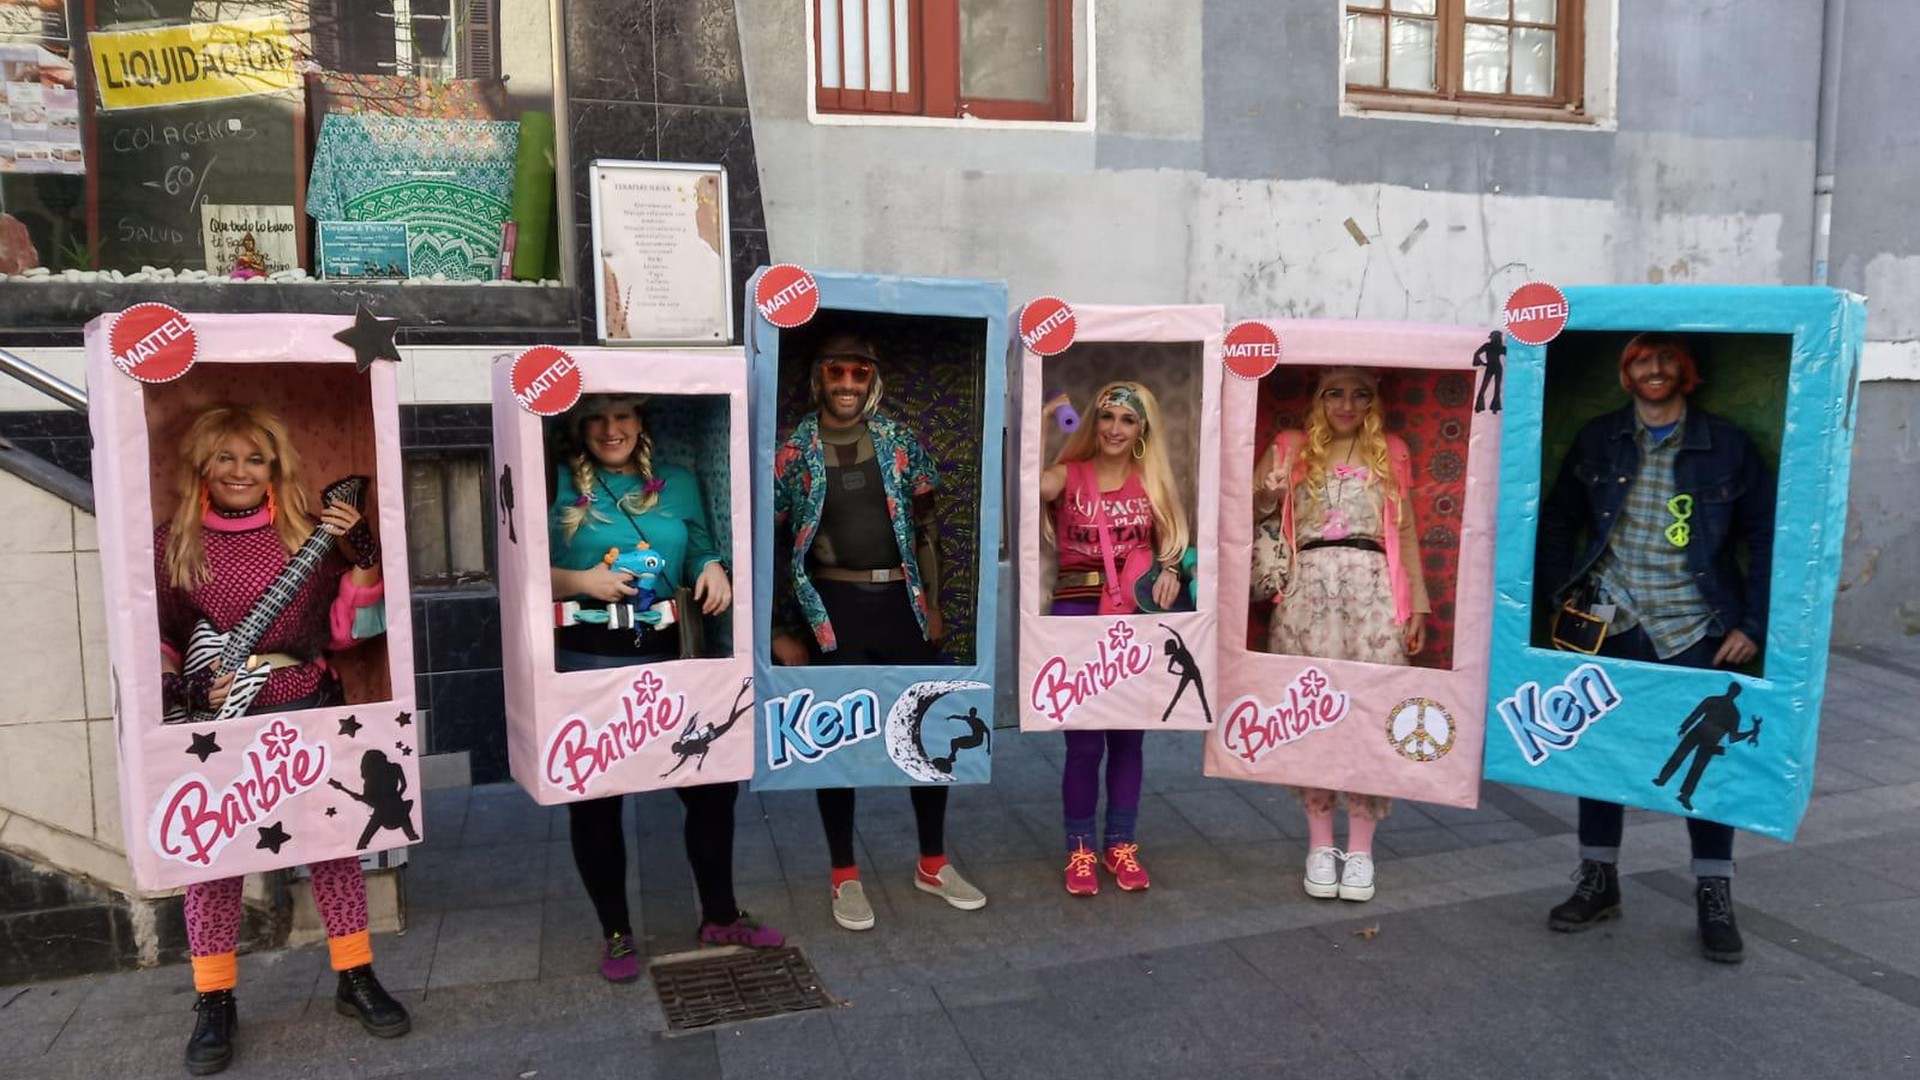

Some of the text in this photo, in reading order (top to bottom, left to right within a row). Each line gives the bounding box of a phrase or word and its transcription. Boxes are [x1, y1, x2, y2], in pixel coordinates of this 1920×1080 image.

[758, 276, 817, 320] MATTEL
[1024, 306, 1076, 350] MATTEL
[1502, 302, 1568, 326] MATTEL
[116, 316, 193, 374] MATTEL
[1221, 342, 1281, 358] MATTEL
[516, 356, 577, 409] MATTEL
[1032, 620, 1152, 723] Barbie
[547, 670, 685, 795] Barbie
[768, 692, 877, 767] Ken
[1224, 670, 1345, 763] Barbie
[1504, 666, 1620, 763] Ken
[160, 720, 326, 866] Barbie
